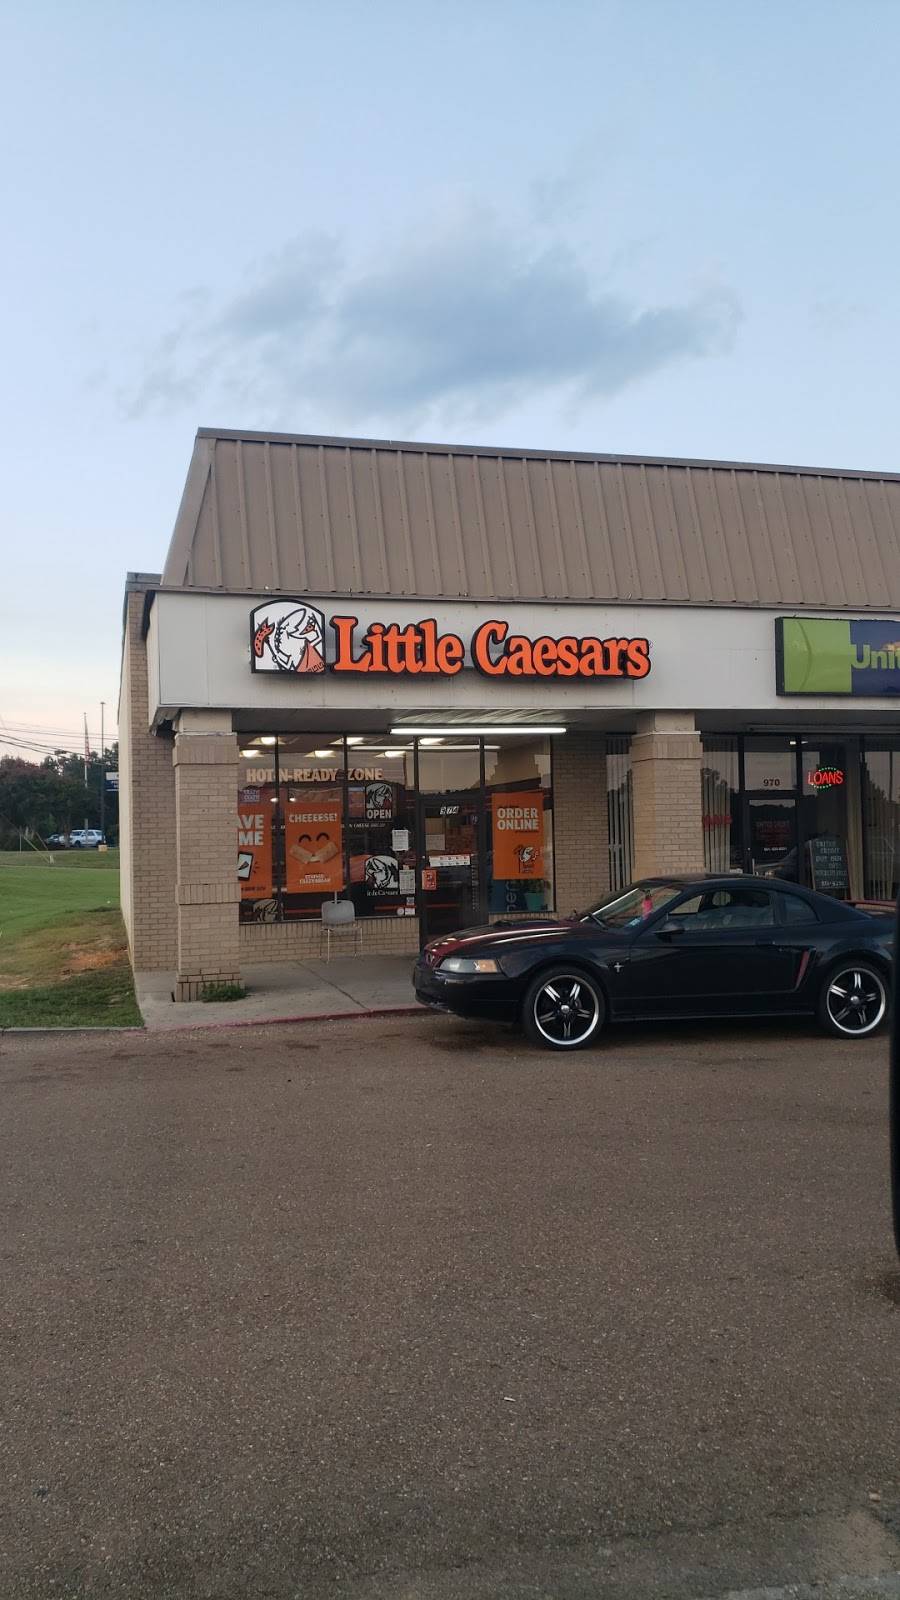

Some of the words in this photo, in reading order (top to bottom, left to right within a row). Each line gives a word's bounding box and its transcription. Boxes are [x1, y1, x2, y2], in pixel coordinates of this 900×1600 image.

[331, 616, 465, 674] Little
[473, 620, 650, 678] Caesars
[347, 767, 384, 781] ZONE
[808, 770, 844, 785] LOANS
[763, 778, 781, 787] 970
[366, 809, 392, 819] OPEN
[496, 807, 539, 819] ORDER
[496, 819, 539, 831] ONLINE
